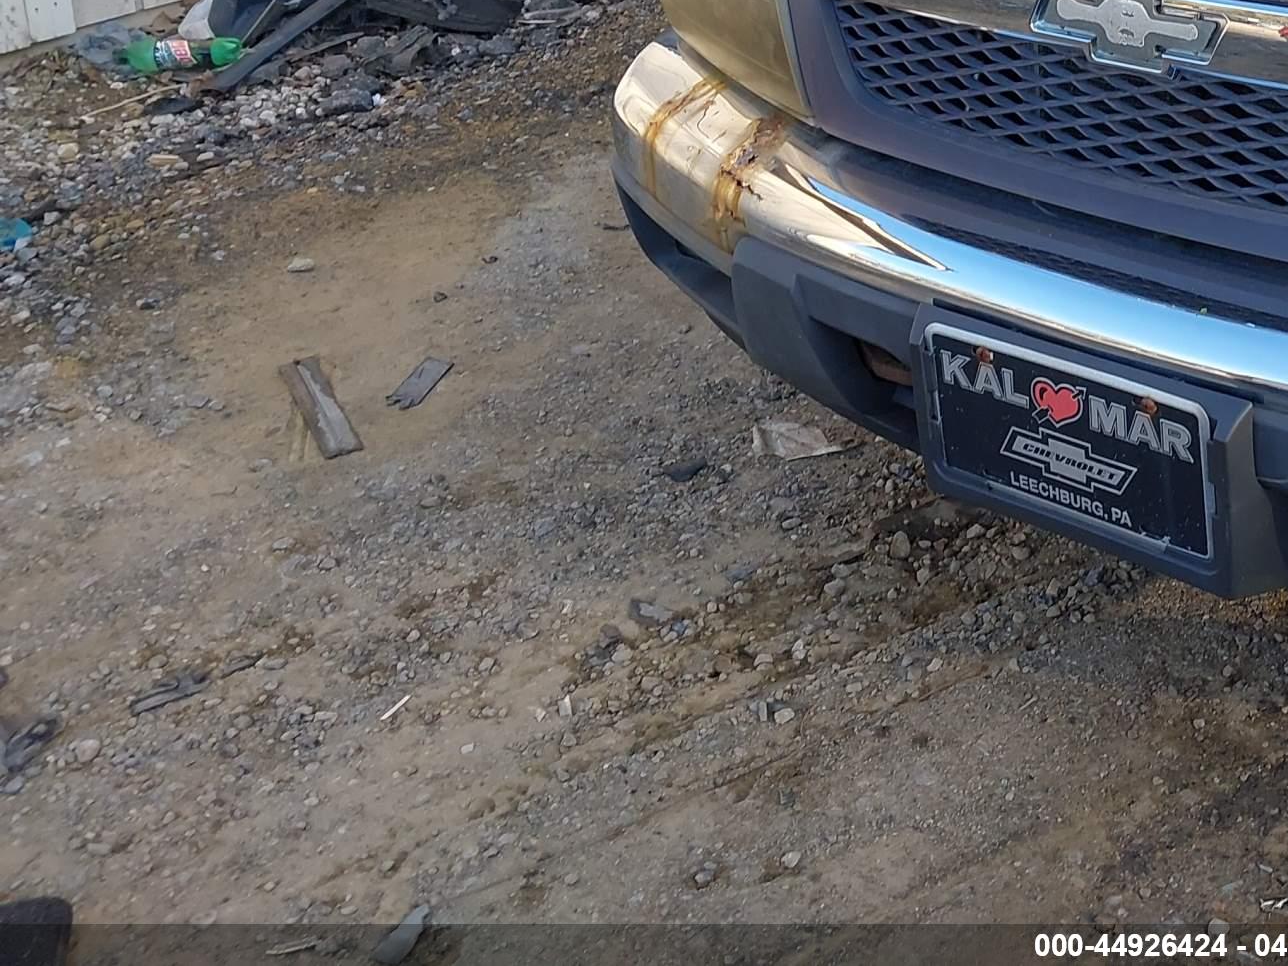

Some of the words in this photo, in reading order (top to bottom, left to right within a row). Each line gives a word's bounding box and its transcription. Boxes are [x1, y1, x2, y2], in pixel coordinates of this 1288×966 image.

[940, 350, 1029, 409] KAL
[1088, 395, 1195, 464] MAR
[1021, 441, 1117, 482] CHEVROLET
[1009, 471, 1109, 521] LEECHBURG,
[1112, 509, 1133, 528] PA
